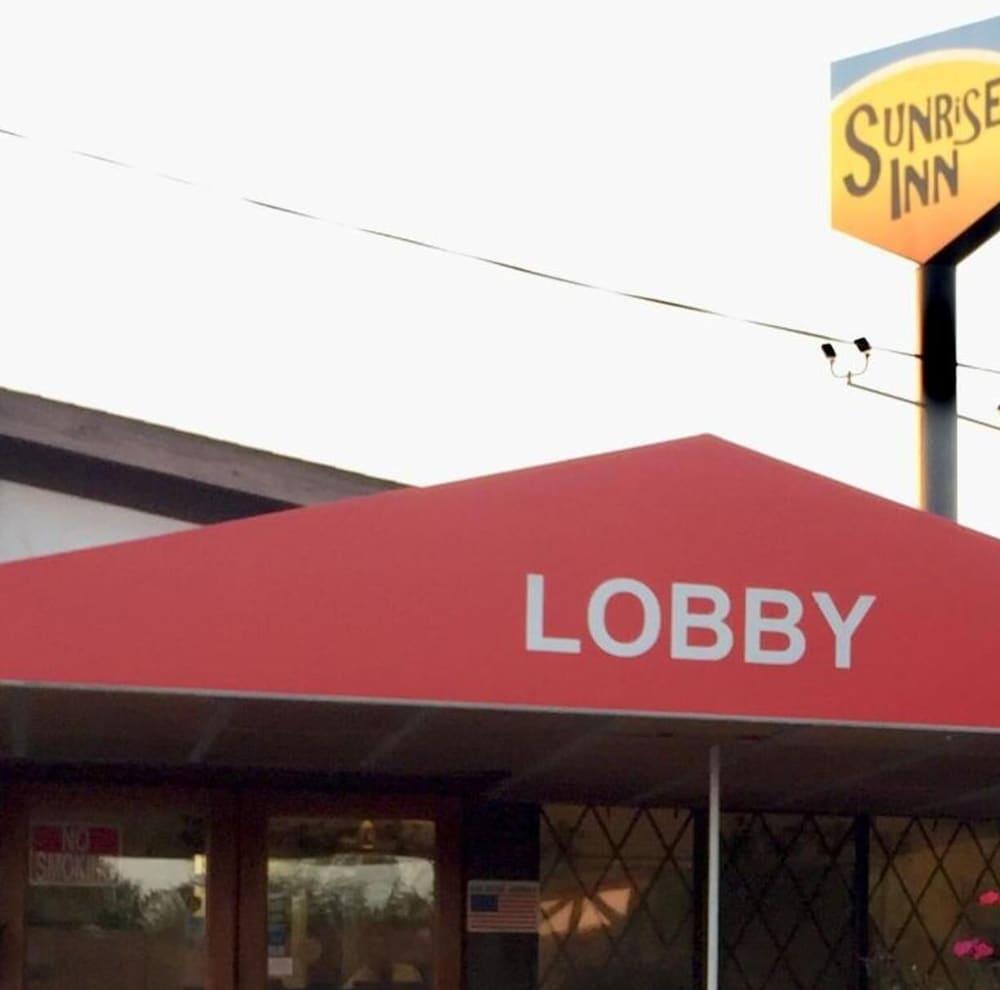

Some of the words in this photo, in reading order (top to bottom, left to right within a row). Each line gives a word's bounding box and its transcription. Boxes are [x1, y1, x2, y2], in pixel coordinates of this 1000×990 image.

[890, 148, 959, 221] INN
[525, 573, 877, 669] LOBBY
[62, 826, 91, 852] NO
[35, 852, 117, 882] SMOKI
